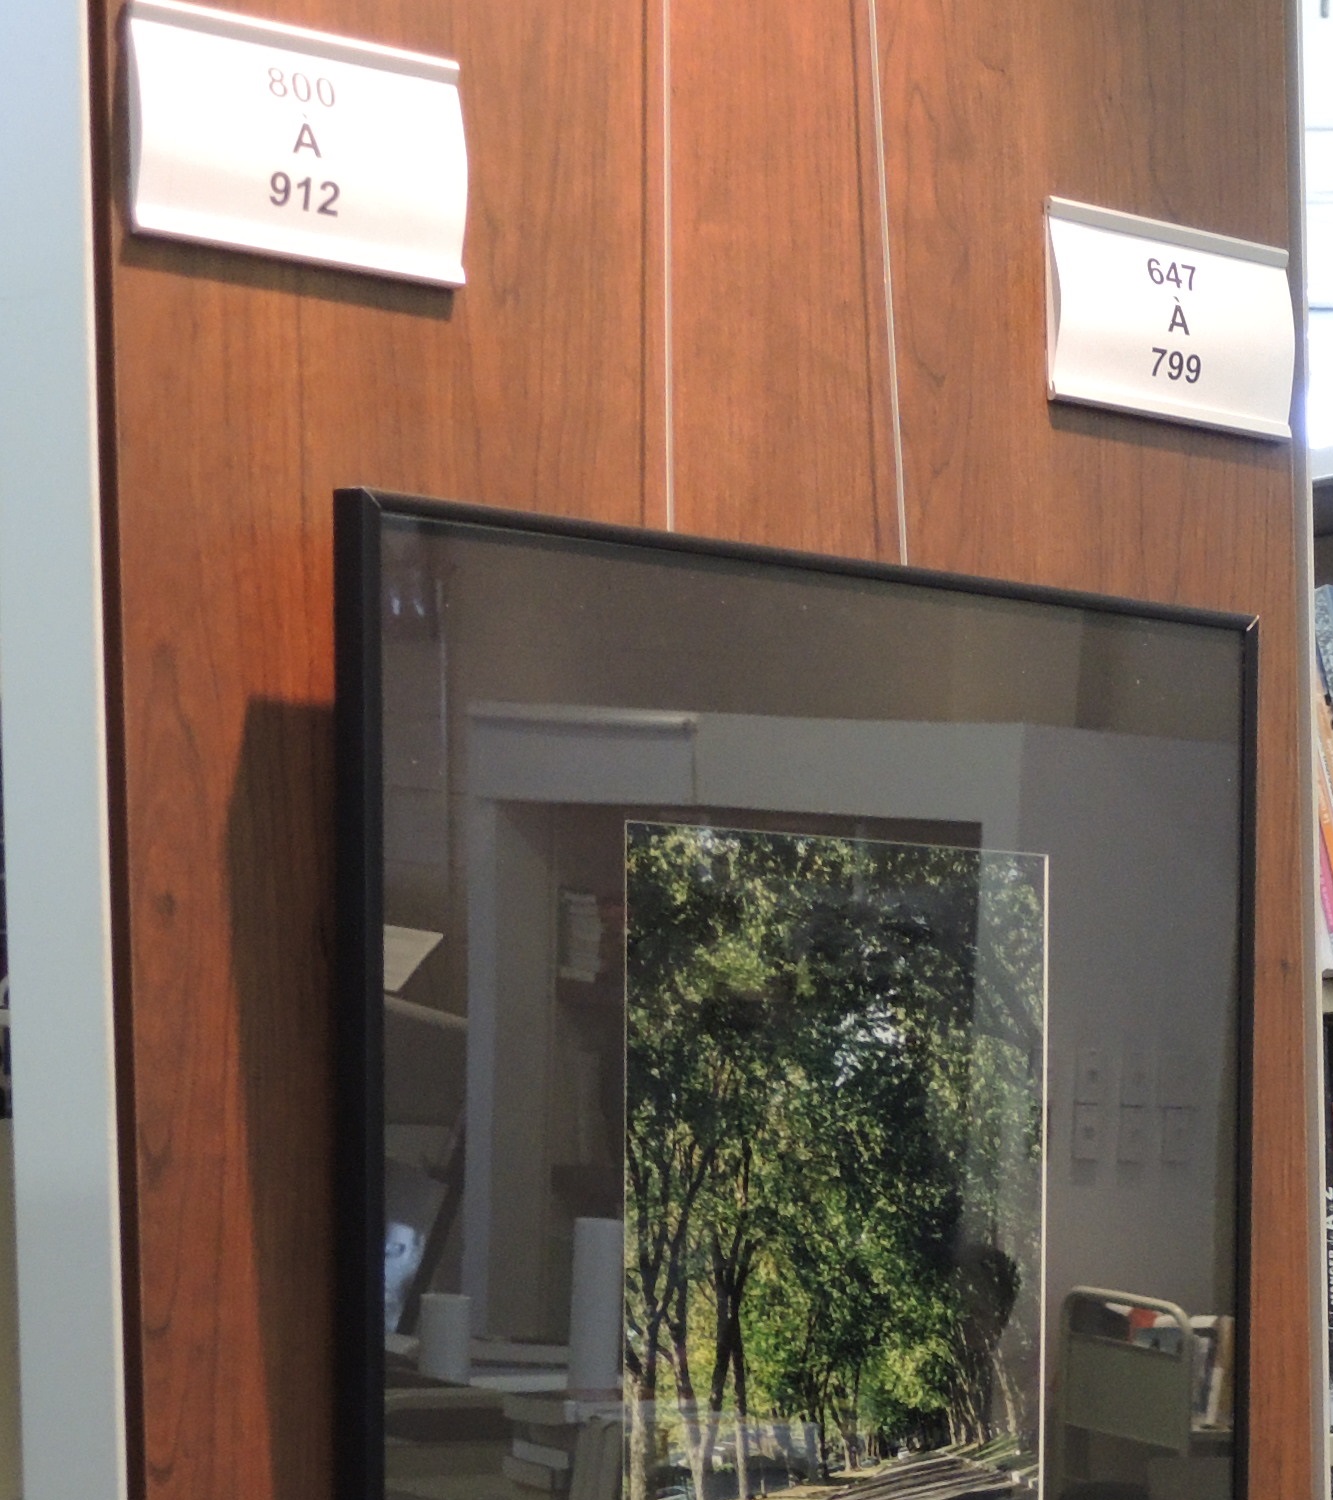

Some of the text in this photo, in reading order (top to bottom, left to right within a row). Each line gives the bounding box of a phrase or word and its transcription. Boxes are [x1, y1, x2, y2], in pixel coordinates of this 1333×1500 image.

[267, 67, 336, 108] 800
[269, 171, 341, 218] 912
[1147, 257, 1197, 291] 647
[1168, 295, 1190, 336] À
[1152, 346, 1202, 384] 799
